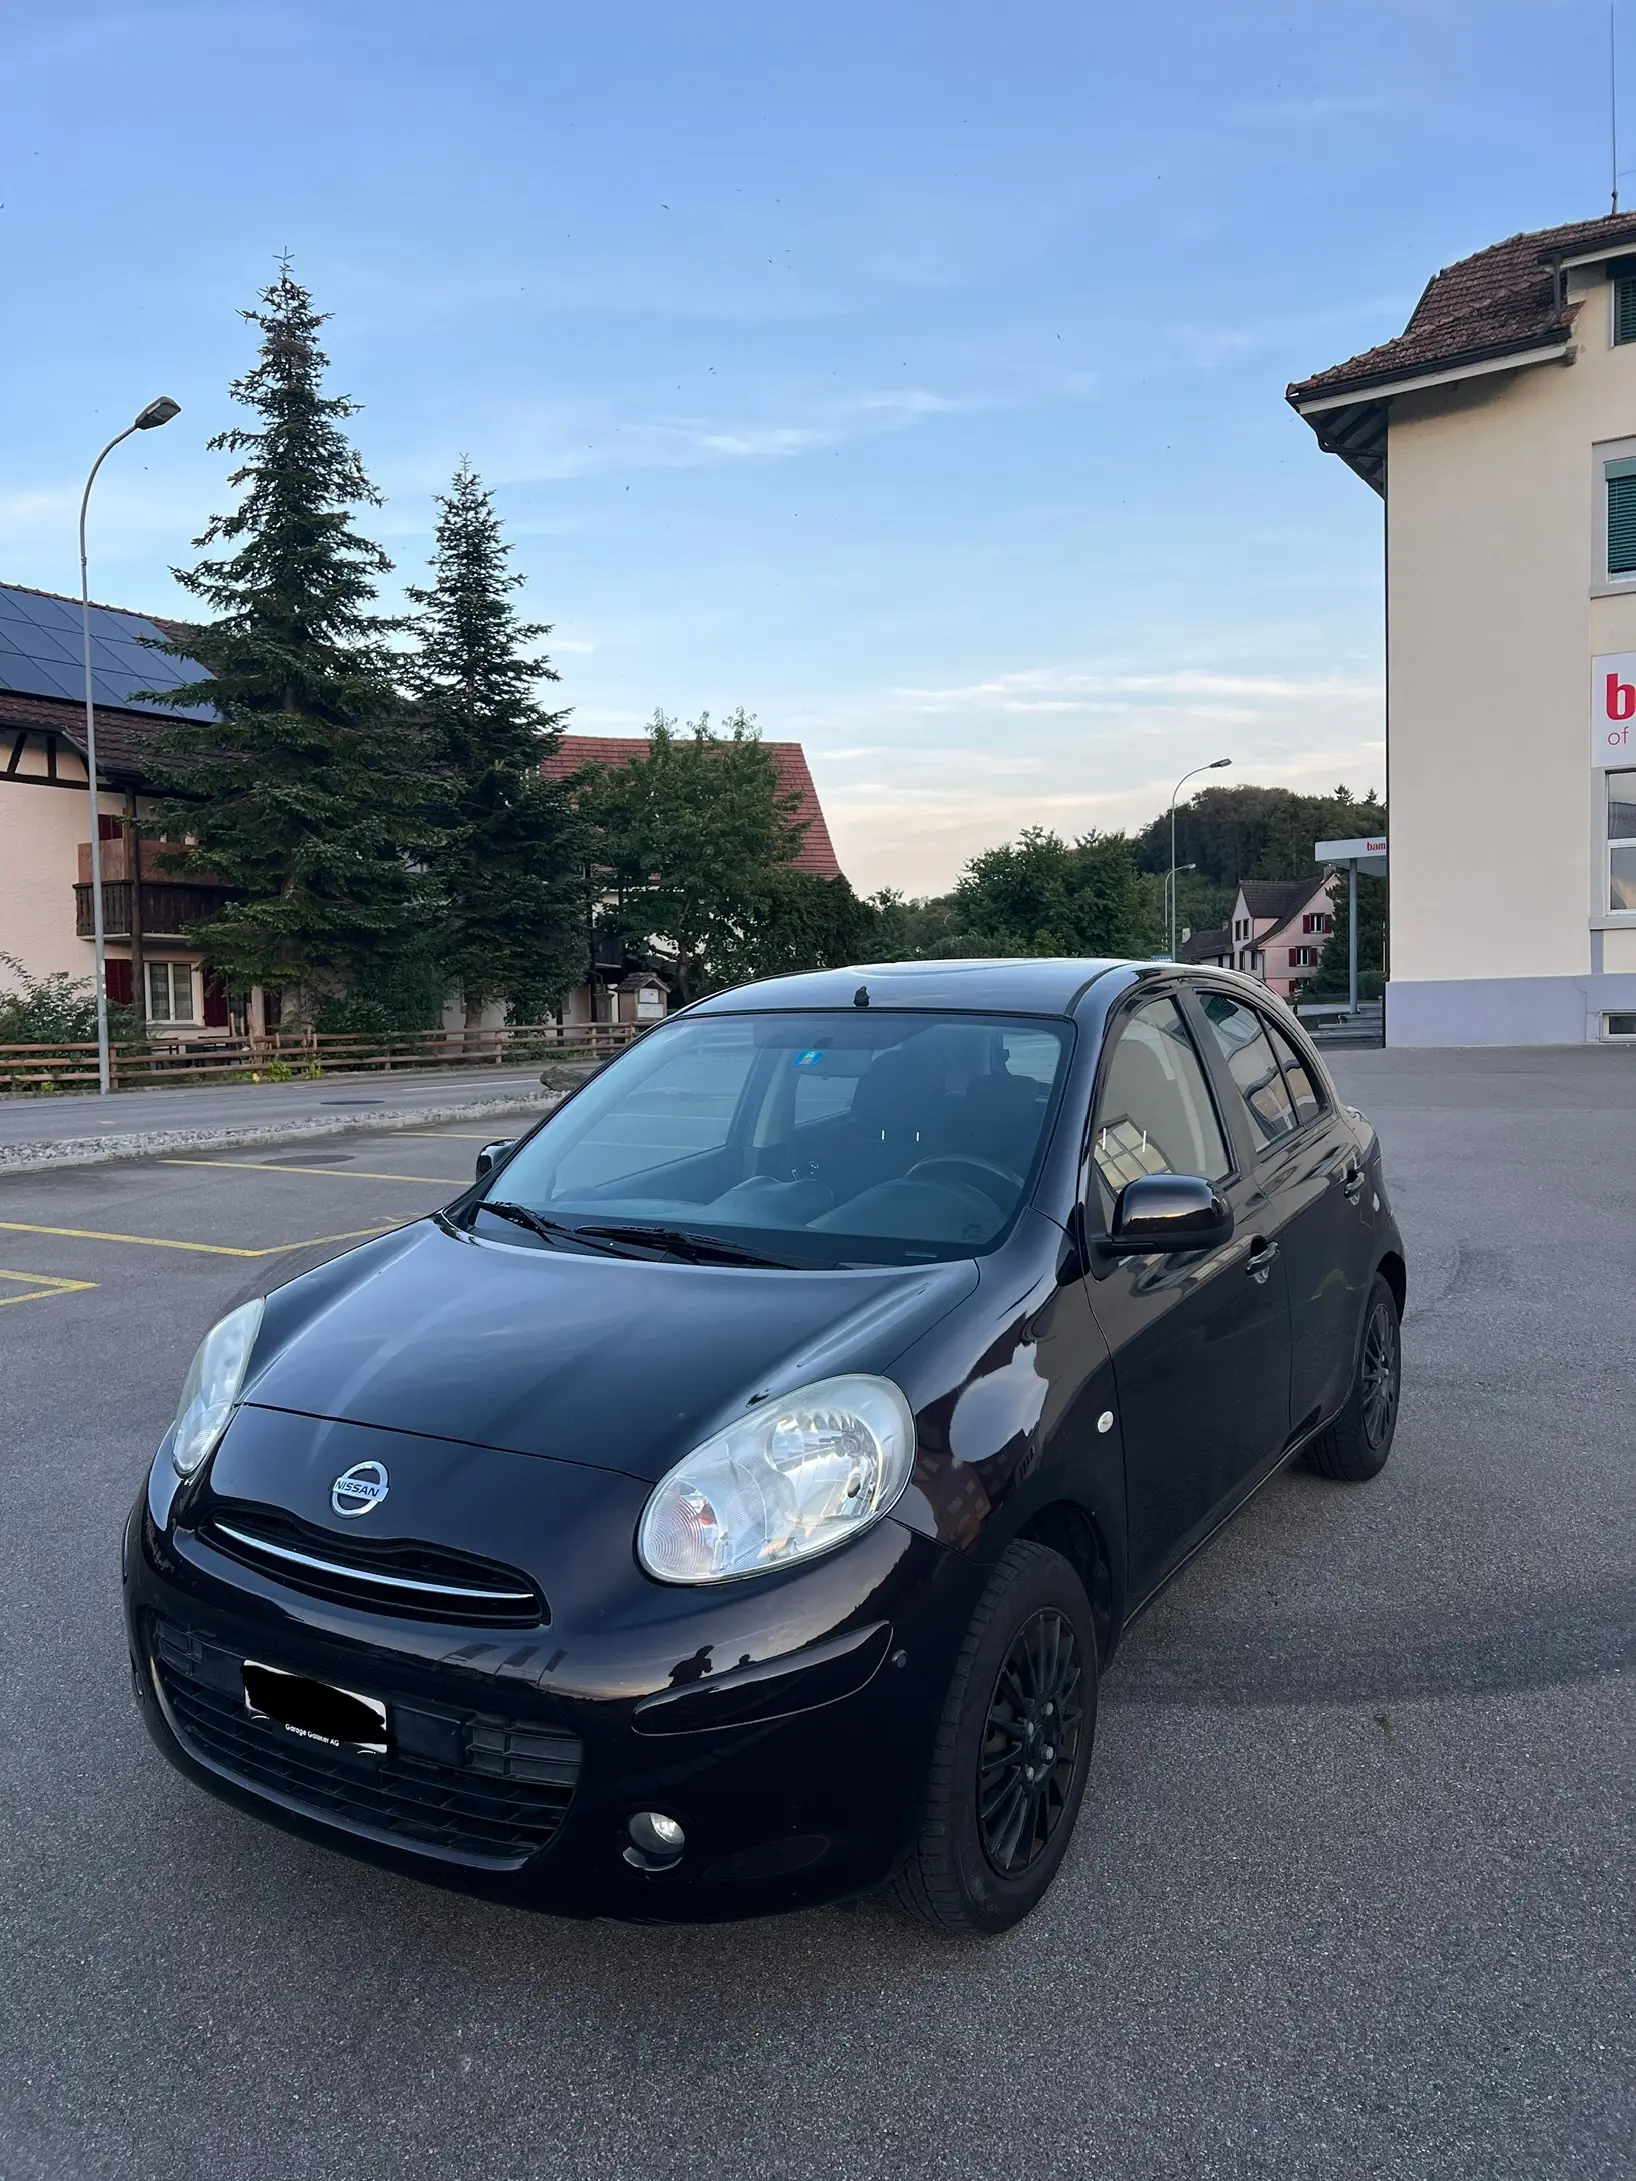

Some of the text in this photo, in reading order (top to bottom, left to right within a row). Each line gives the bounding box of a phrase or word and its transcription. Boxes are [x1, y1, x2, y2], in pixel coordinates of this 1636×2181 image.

[1606, 672, 1636, 720] b
[1607, 726, 1630, 745] of
[335, 1480, 380, 1497] NISSAN
[285, 1723, 307, 1736] Garage
[330, 1739, 340, 1747] AG
